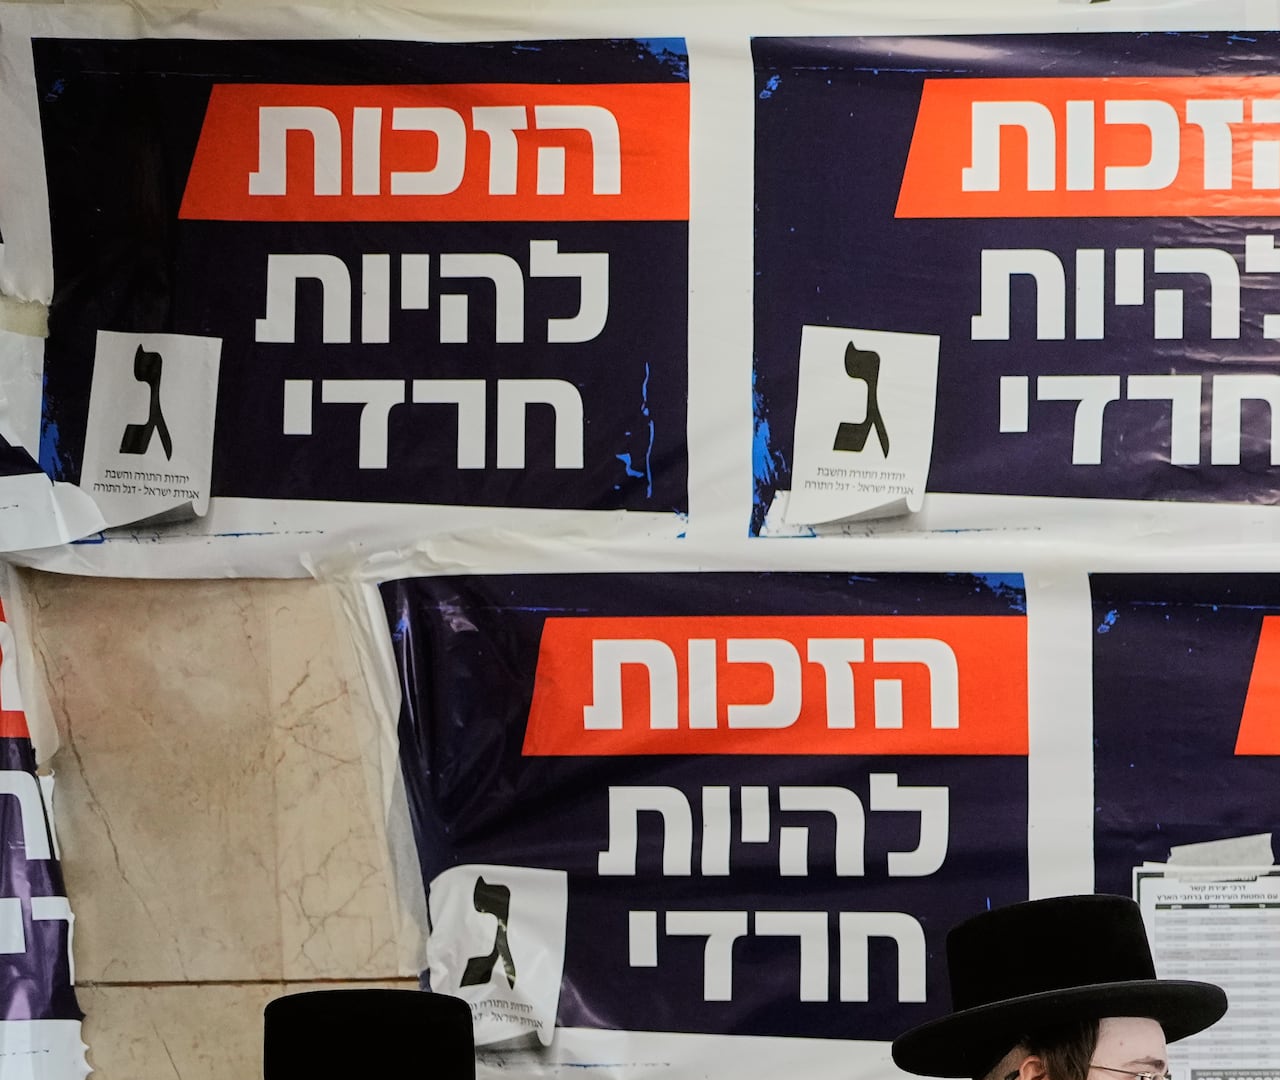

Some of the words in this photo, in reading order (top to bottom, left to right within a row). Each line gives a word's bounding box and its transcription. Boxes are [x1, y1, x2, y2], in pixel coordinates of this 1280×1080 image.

[249, 106, 620, 195] הזכות
[256, 241, 608, 343] להיות
[119, 344, 172, 461] ג
[833, 341, 889, 459] ג
[284, 380, 583, 468] חרדי
[105, 469, 132, 479] והשבת
[134, 471, 162, 481] התורה
[817, 466, 846, 477] והשבת
[849, 470, 877, 478] התורה
[880, 472, 906, 481] יהדות
[164, 474, 189, 484] יהדות
[93, 482, 121, 493] התורה
[122, 483, 136, 495] דגל
[805, 480, 833, 490] התורה
[835, 481, 850, 491] דגל
[857, 483, 886, 492] ישראל
[888, 485, 914, 495] אגודת
[143, 486, 172, 497] ישראל
[173, 489, 199, 499] אגודת
[584, 639, 959, 729] הזכות
[599, 774, 948, 876] להיות
[459, 875, 515, 990] ג
[629, 911, 926, 1002] חרדי
